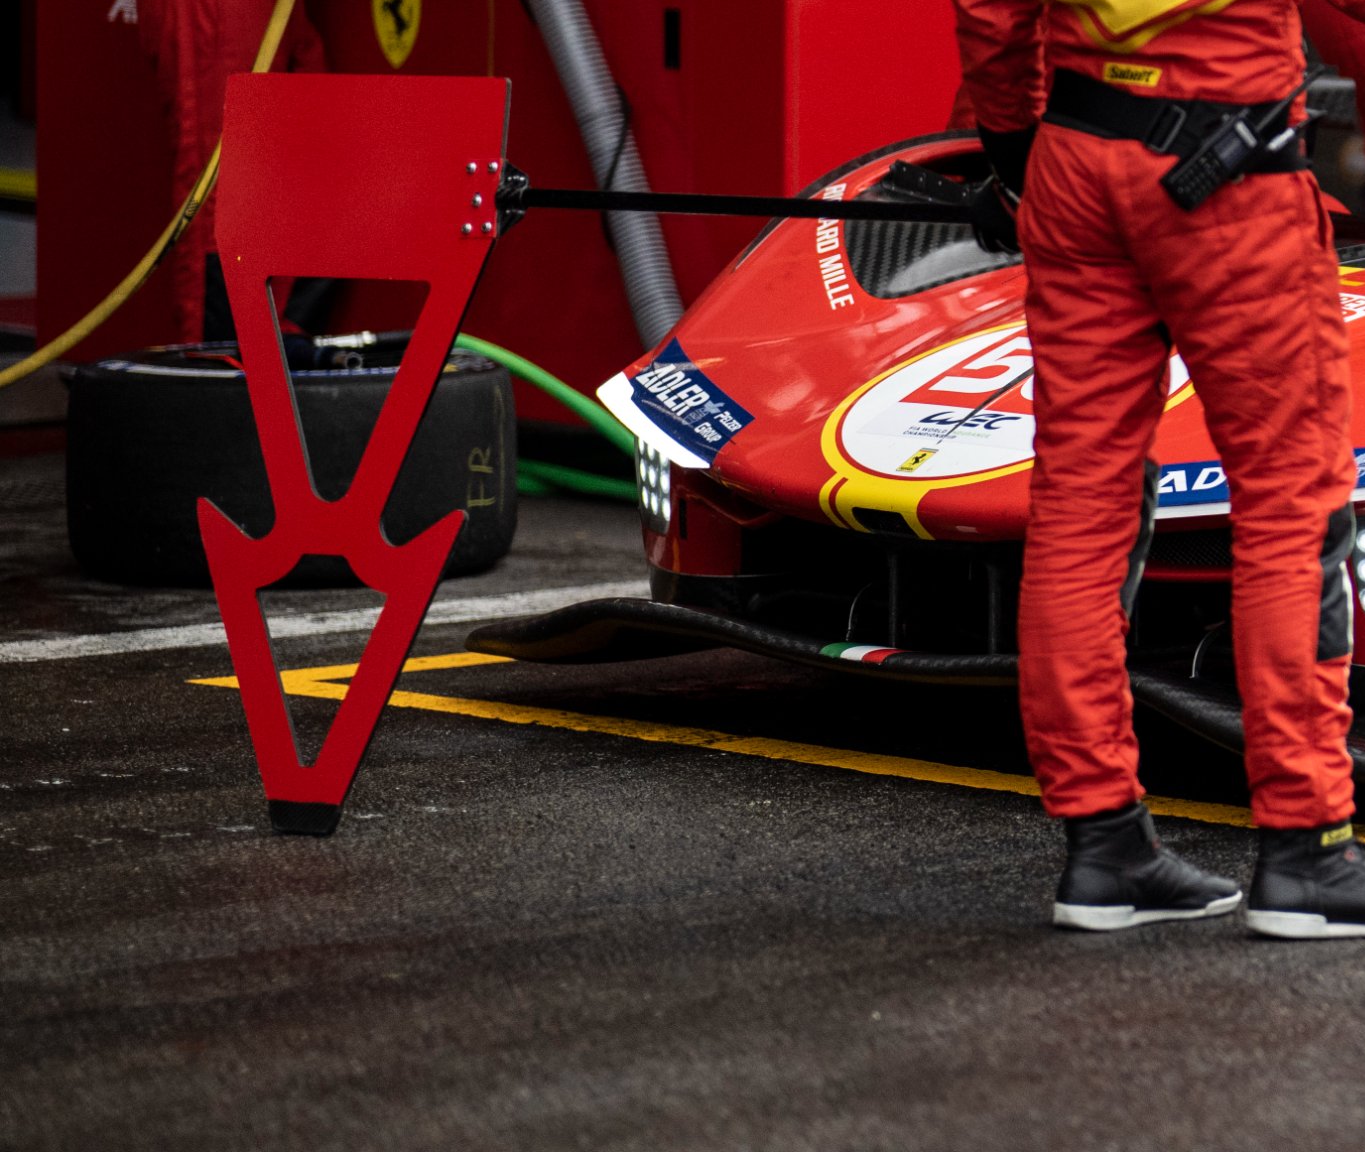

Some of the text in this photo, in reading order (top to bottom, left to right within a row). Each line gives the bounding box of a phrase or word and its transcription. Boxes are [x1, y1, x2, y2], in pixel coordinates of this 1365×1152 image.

[816, 182, 855, 311] RIARD MILLE
[928, 335, 1036, 402] 5
[635, 363, 711, 417] ADLER
[694, 421, 723, 443] GROUP
[918, 410, 1023, 431] WEC
[1157, 466, 1228, 494] AD
